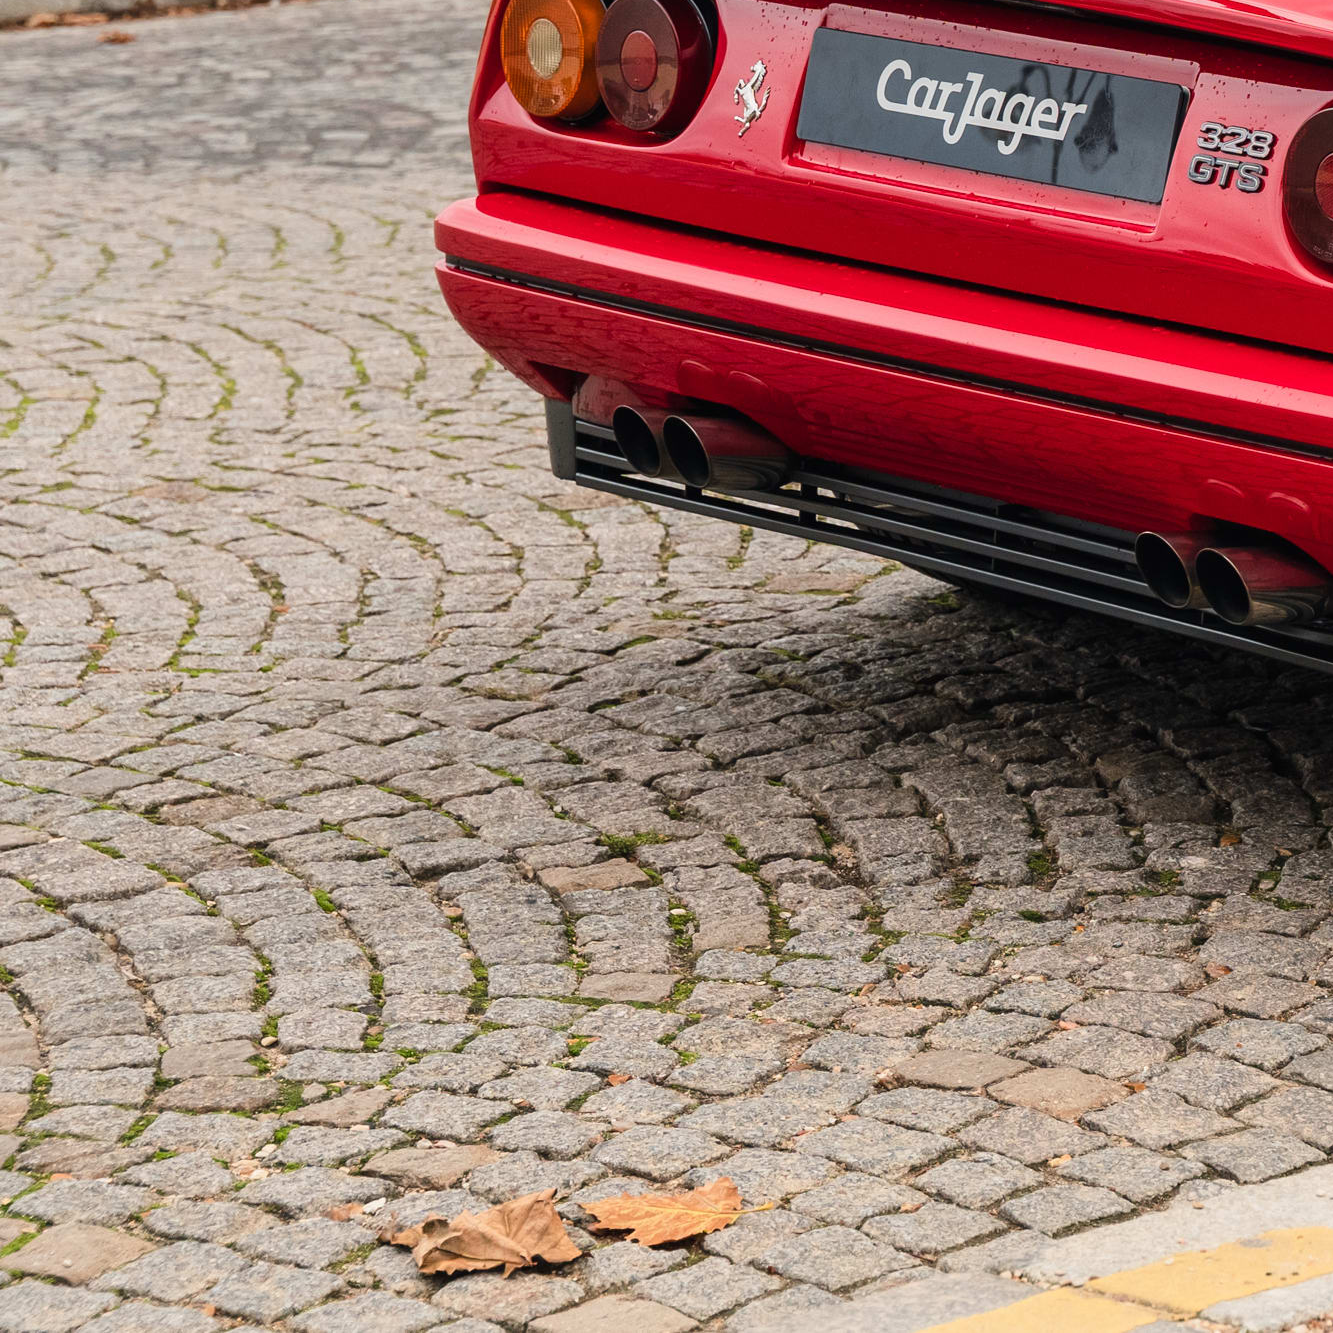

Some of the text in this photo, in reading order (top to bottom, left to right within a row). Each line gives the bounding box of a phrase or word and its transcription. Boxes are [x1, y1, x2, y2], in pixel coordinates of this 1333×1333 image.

[877, 59, 1087, 155] CarJager
[1197, 121, 1273, 158] 328
[1188, 154, 1263, 192] GTS
